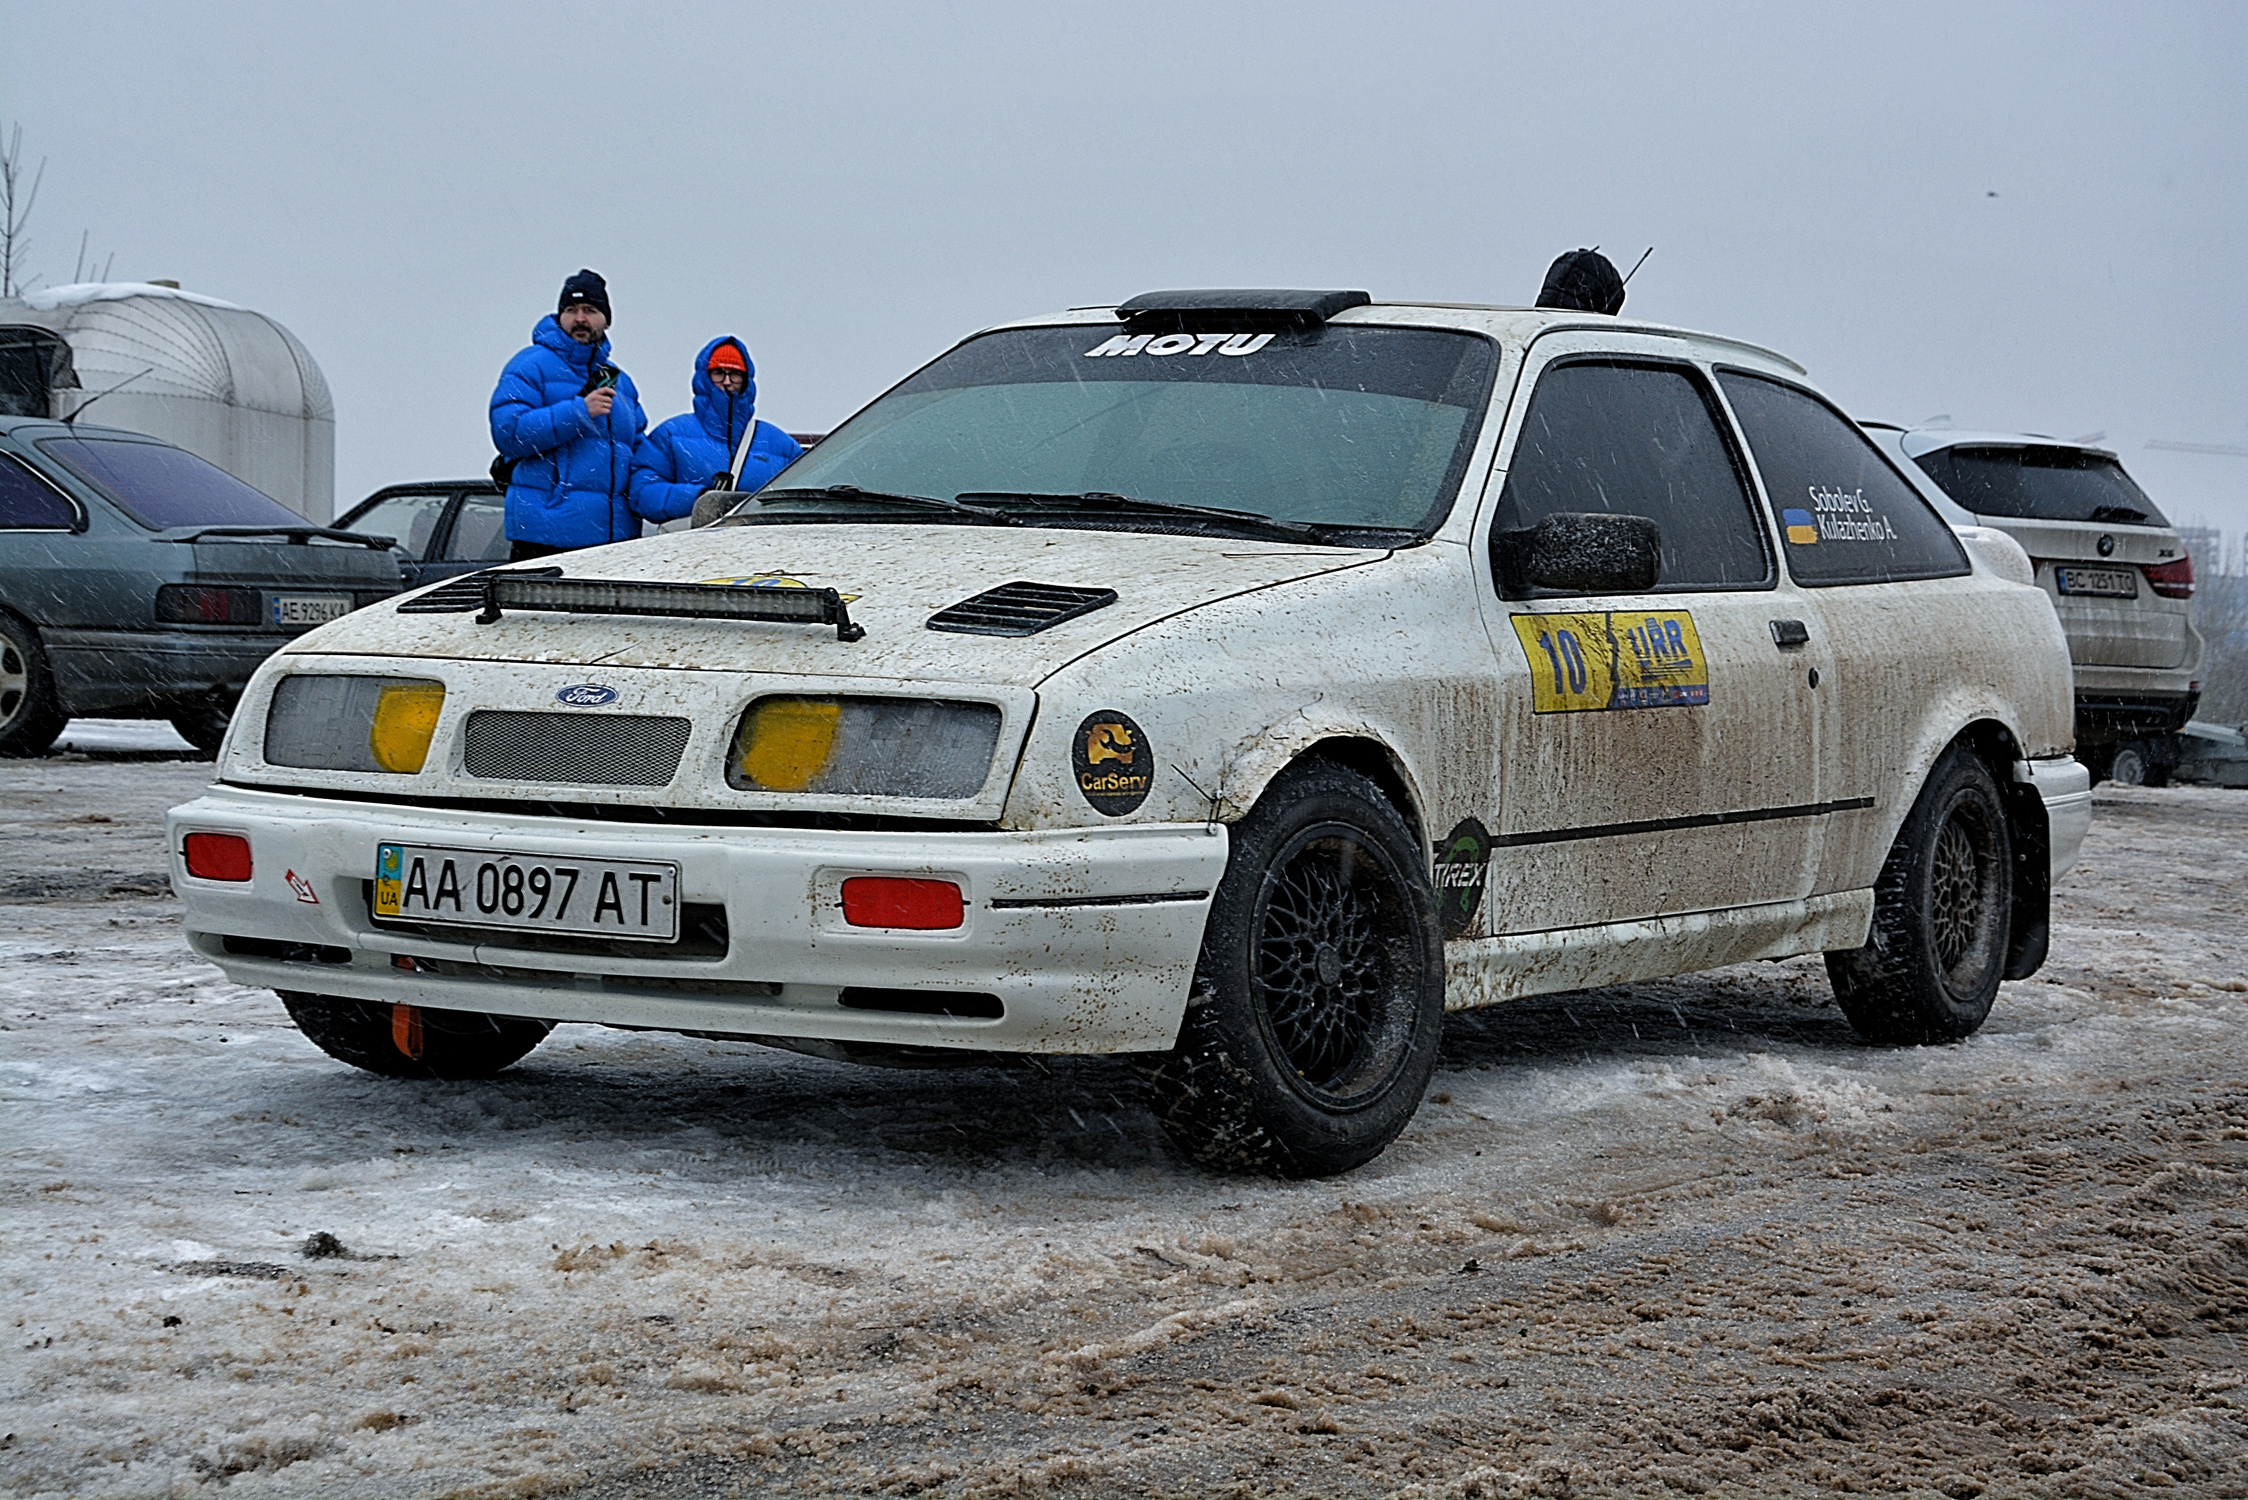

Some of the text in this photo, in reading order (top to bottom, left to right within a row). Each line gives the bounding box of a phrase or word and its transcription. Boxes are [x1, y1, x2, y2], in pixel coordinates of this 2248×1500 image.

[1084, 333, 1276, 356] MOTU
[1809, 485, 1858, 512] Sobolev
[1817, 514, 1883, 541] Kulazhenko
[2066, 571, 2086, 588] BC
[281, 602, 298, 621] AE
[301, 602, 327, 621] 9296
[1538, 628, 1587, 695] 10
[565, 687, 608, 704] Ford
[1081, 772, 1147, 791] CarServ
[1434, 862, 1486, 889] TIREX
[380, 892, 398, 906] UA
[402, 857, 662, 926] AA 0897 AT
